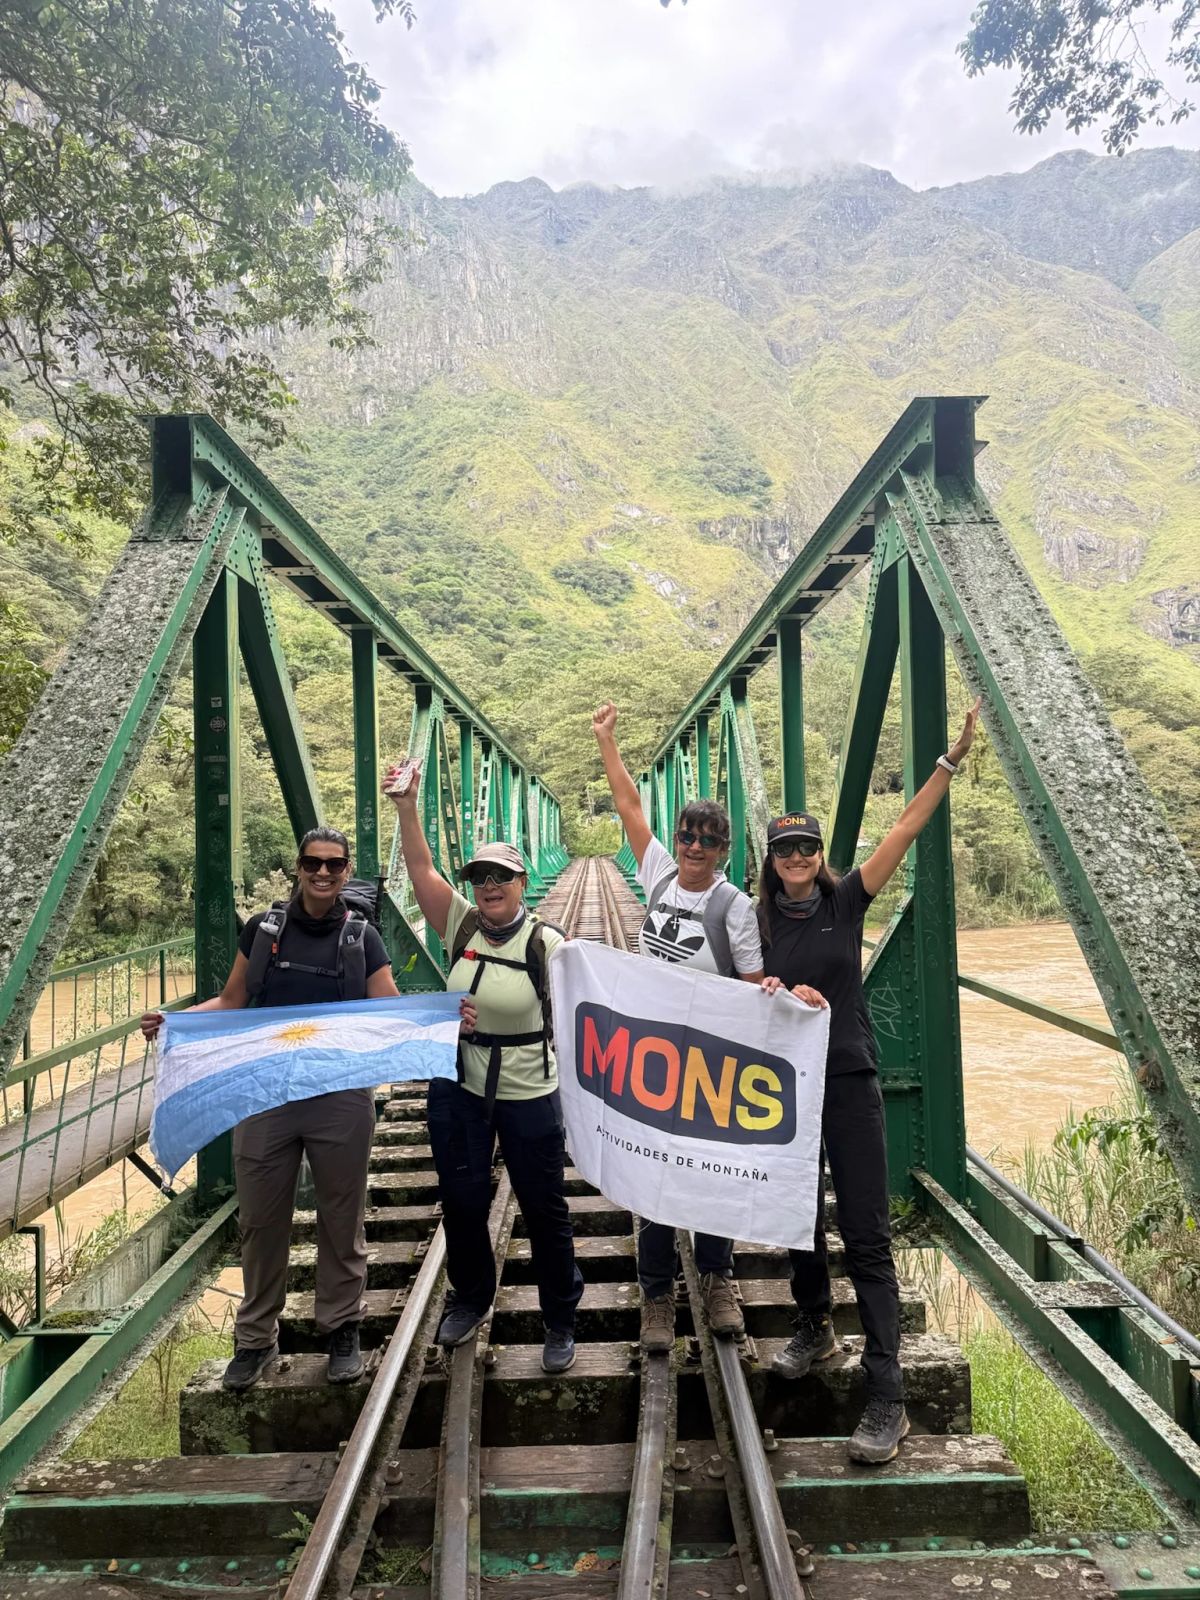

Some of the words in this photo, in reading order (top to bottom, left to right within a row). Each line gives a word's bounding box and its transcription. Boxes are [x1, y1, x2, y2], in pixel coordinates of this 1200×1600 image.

[777, 817, 807, 828] MONS
[583, 1017, 783, 1130] MONS
[676, 1156, 694, 1168] DE
[701, 1161, 768, 1182] MONTAÑA
